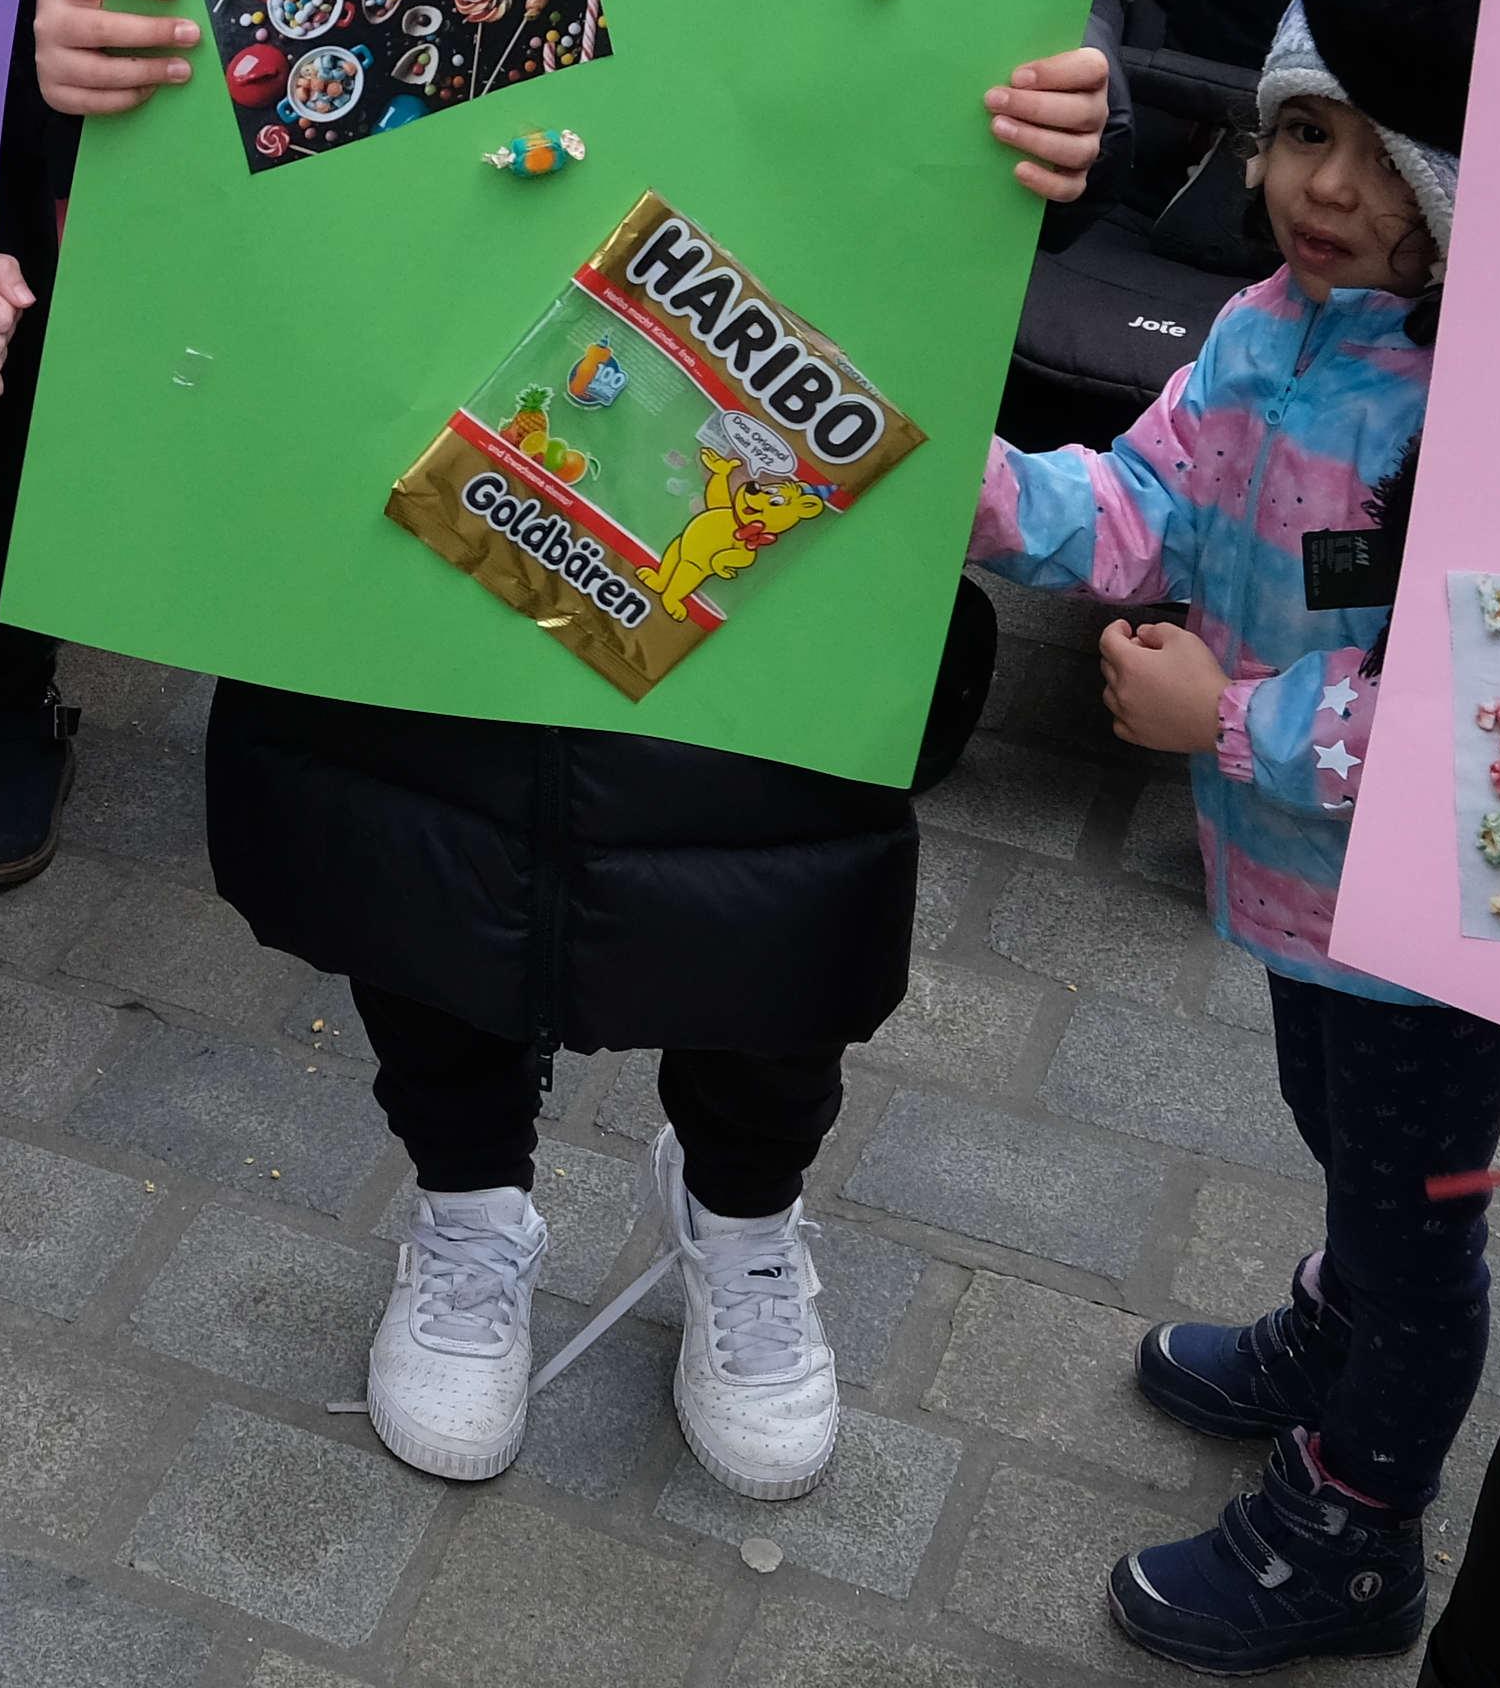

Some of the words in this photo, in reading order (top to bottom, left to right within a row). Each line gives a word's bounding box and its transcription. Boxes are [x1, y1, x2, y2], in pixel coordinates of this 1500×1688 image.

[629, 220, 882, 462] HARIBO
[1128, 314, 1187, 338] Joie
[732, 415, 751, 434] Das
[751, 431, 791, 463] Original
[750, 446, 775, 467] 1922
[465, 473, 650, 626] Goldbären
